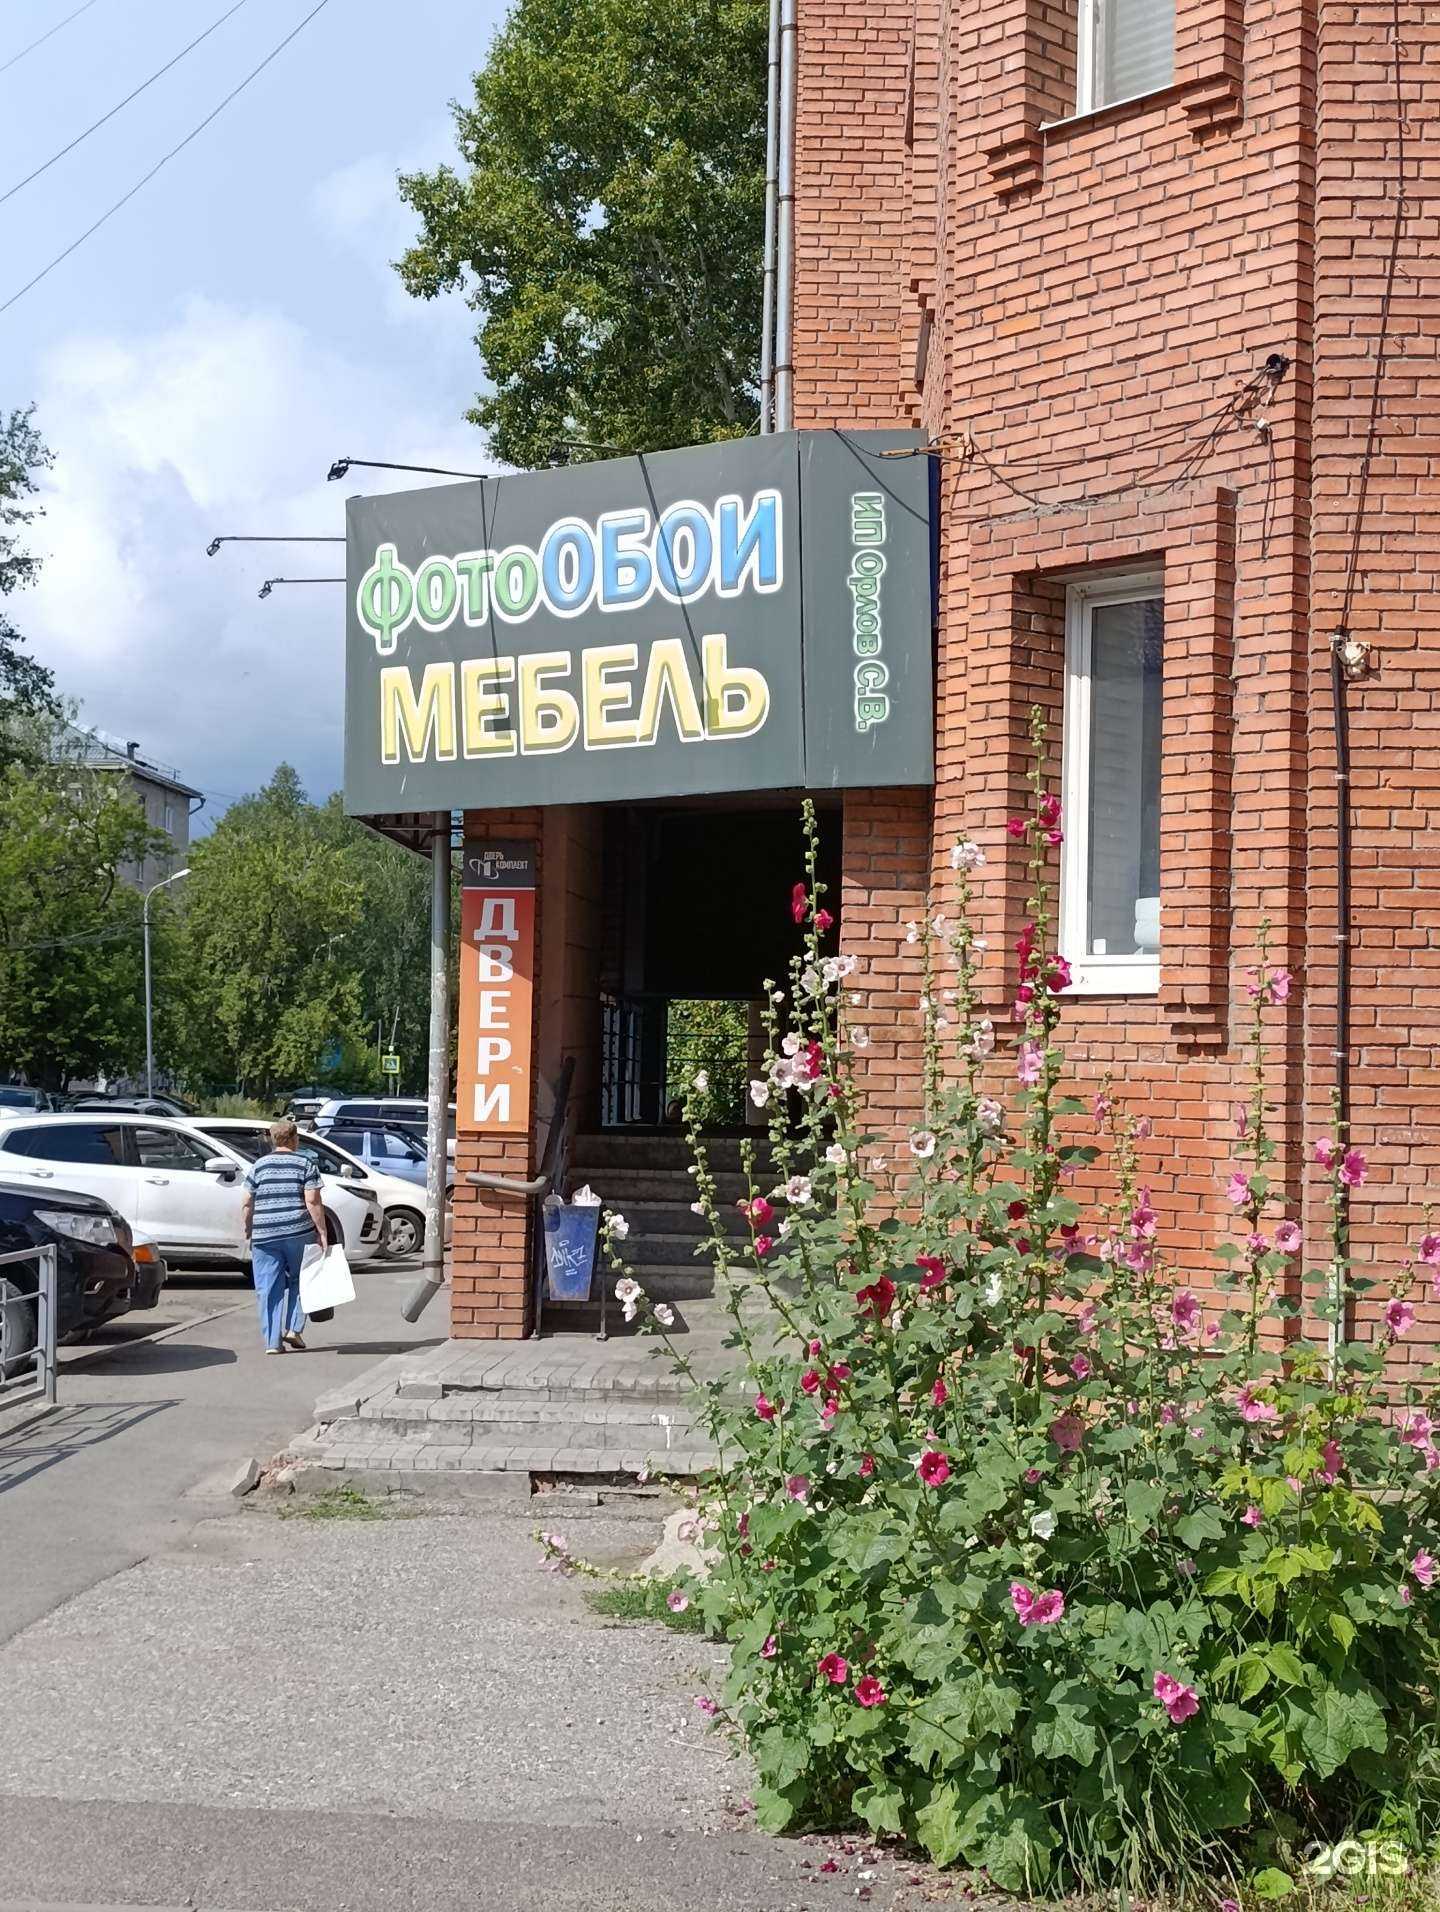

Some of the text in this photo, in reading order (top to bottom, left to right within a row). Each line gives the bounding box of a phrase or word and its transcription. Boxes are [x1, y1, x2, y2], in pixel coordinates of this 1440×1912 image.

[382, 636, 768, 763] МЕБЕЛЬ
[848, 494, 887, 730] ИП Орлов С.В.
[473, 898, 519, 1122] ДВЕРИ
